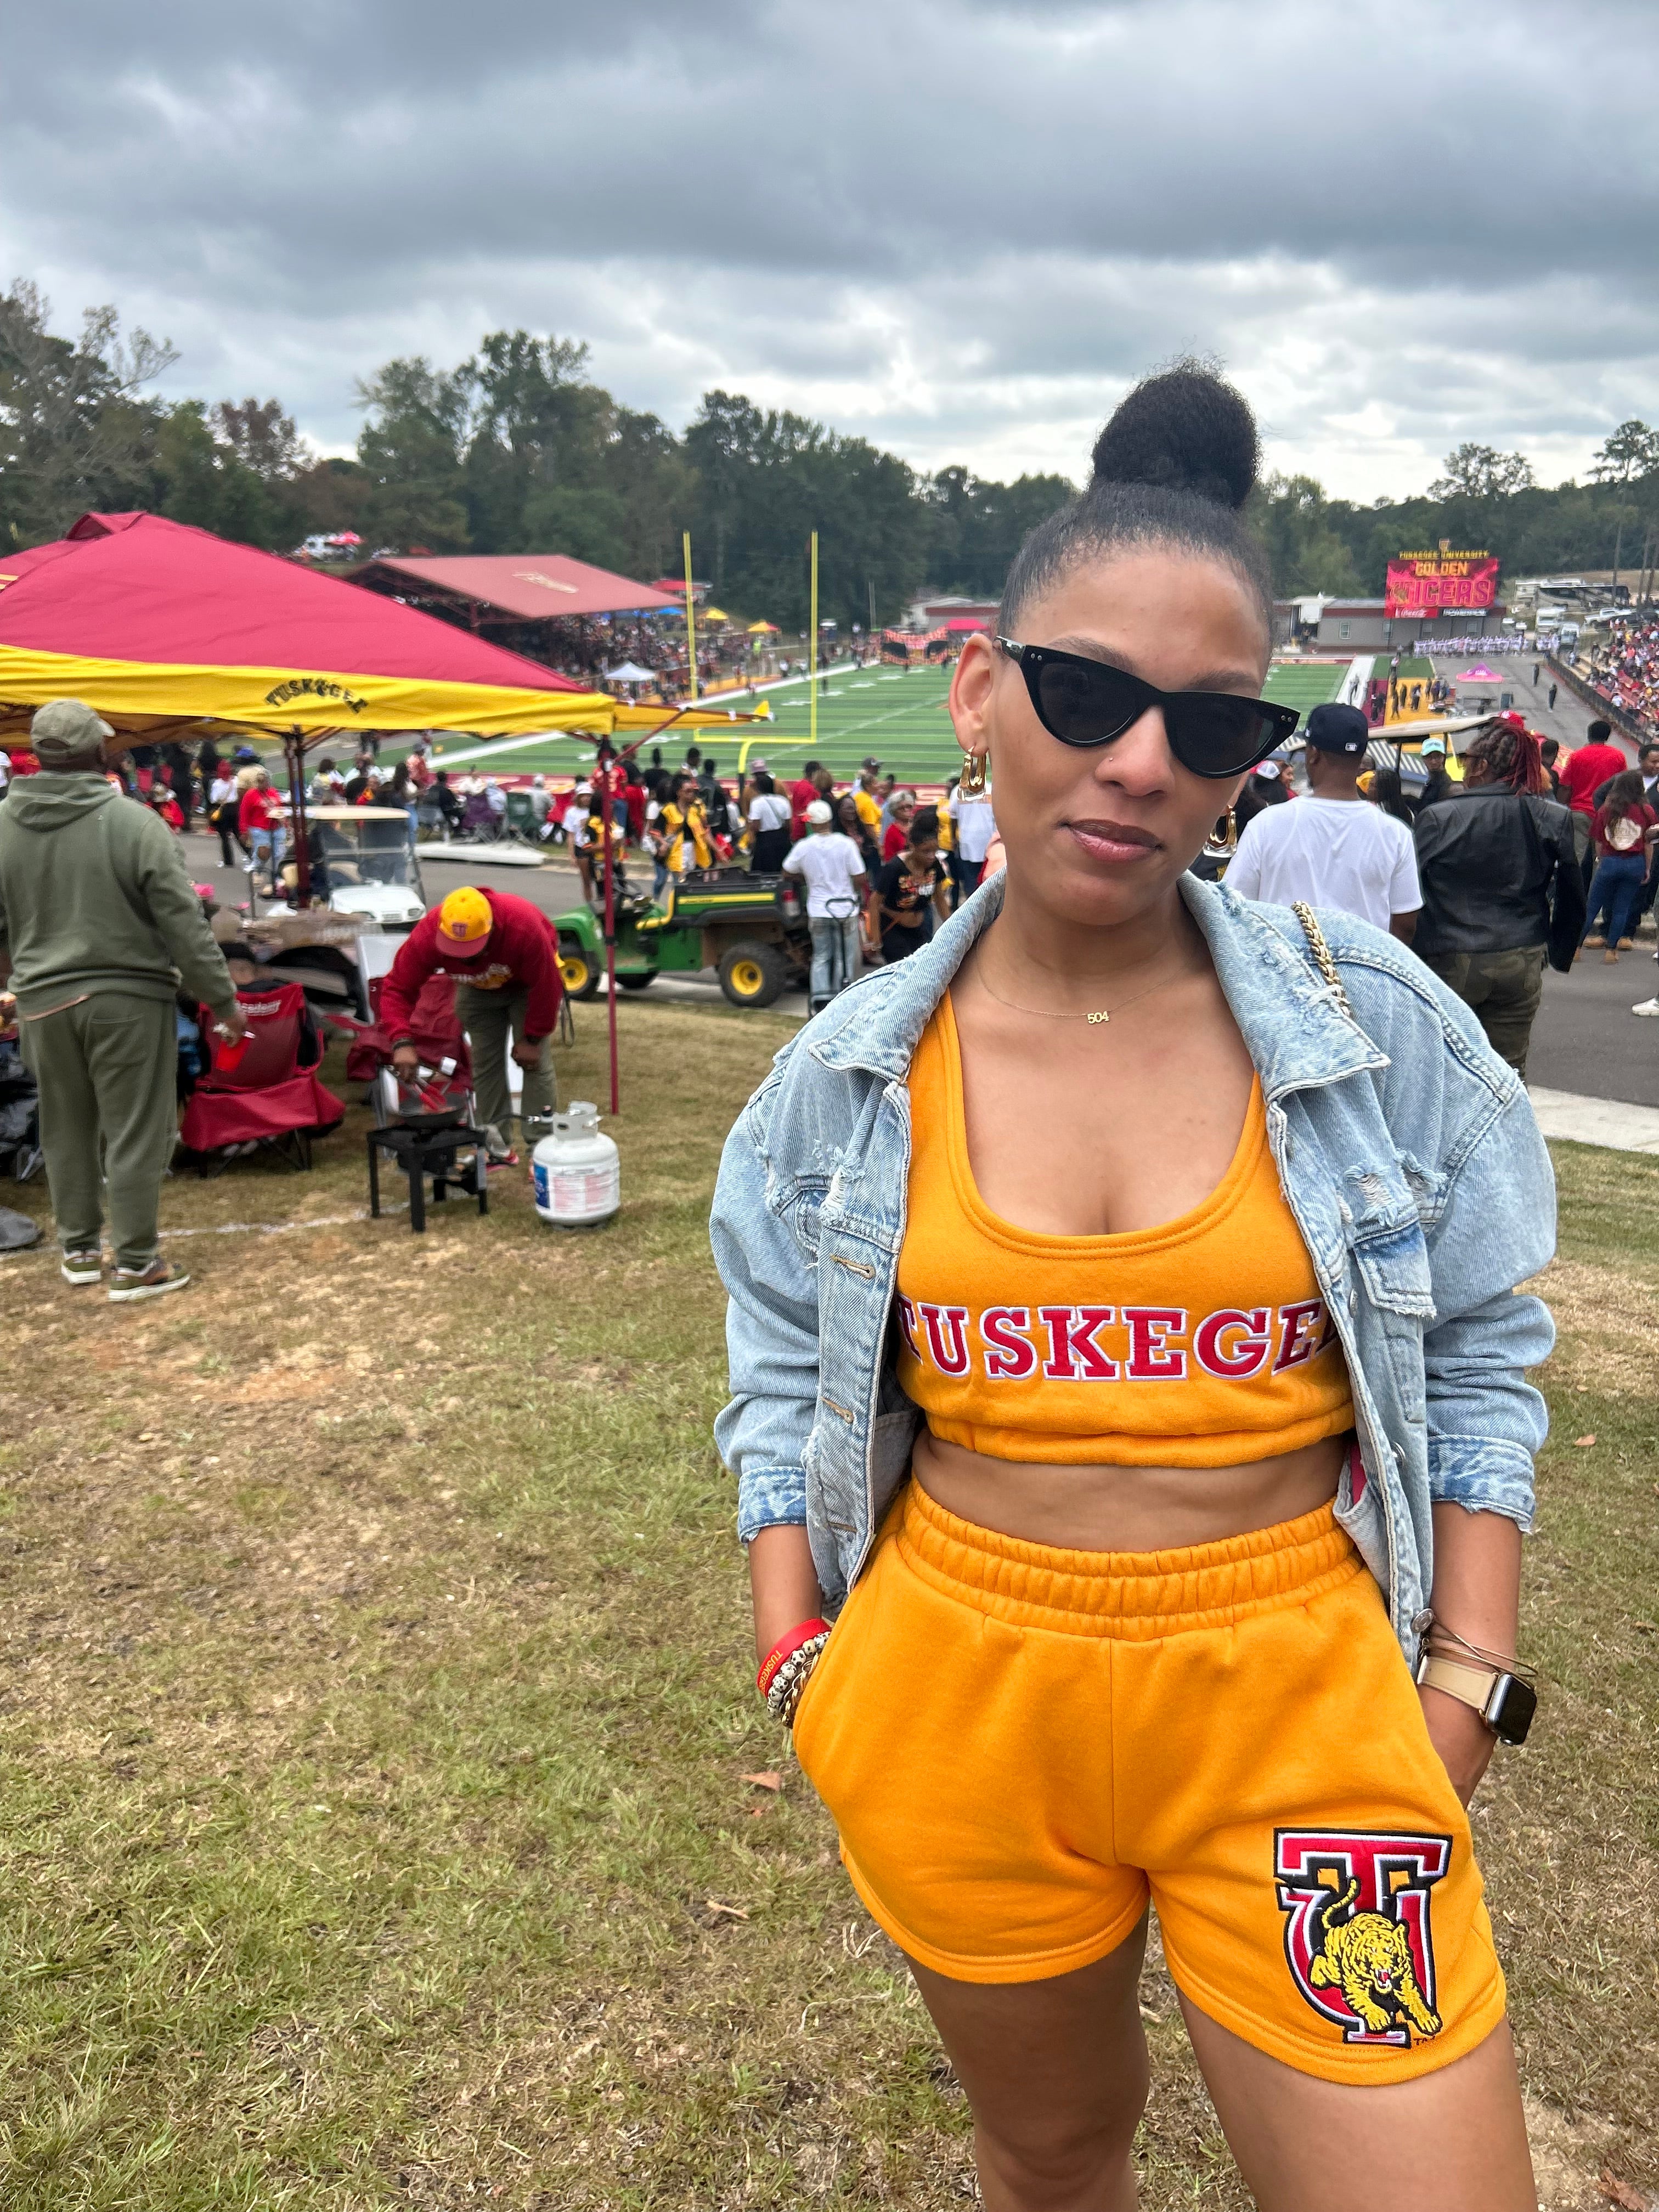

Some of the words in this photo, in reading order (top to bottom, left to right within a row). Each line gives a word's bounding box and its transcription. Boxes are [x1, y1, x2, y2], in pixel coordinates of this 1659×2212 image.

[1415, 561, 1469, 576] GOLDEN
[1390, 579, 1491, 607] TIGERS
[1087, 1011, 1110, 1025] 504
